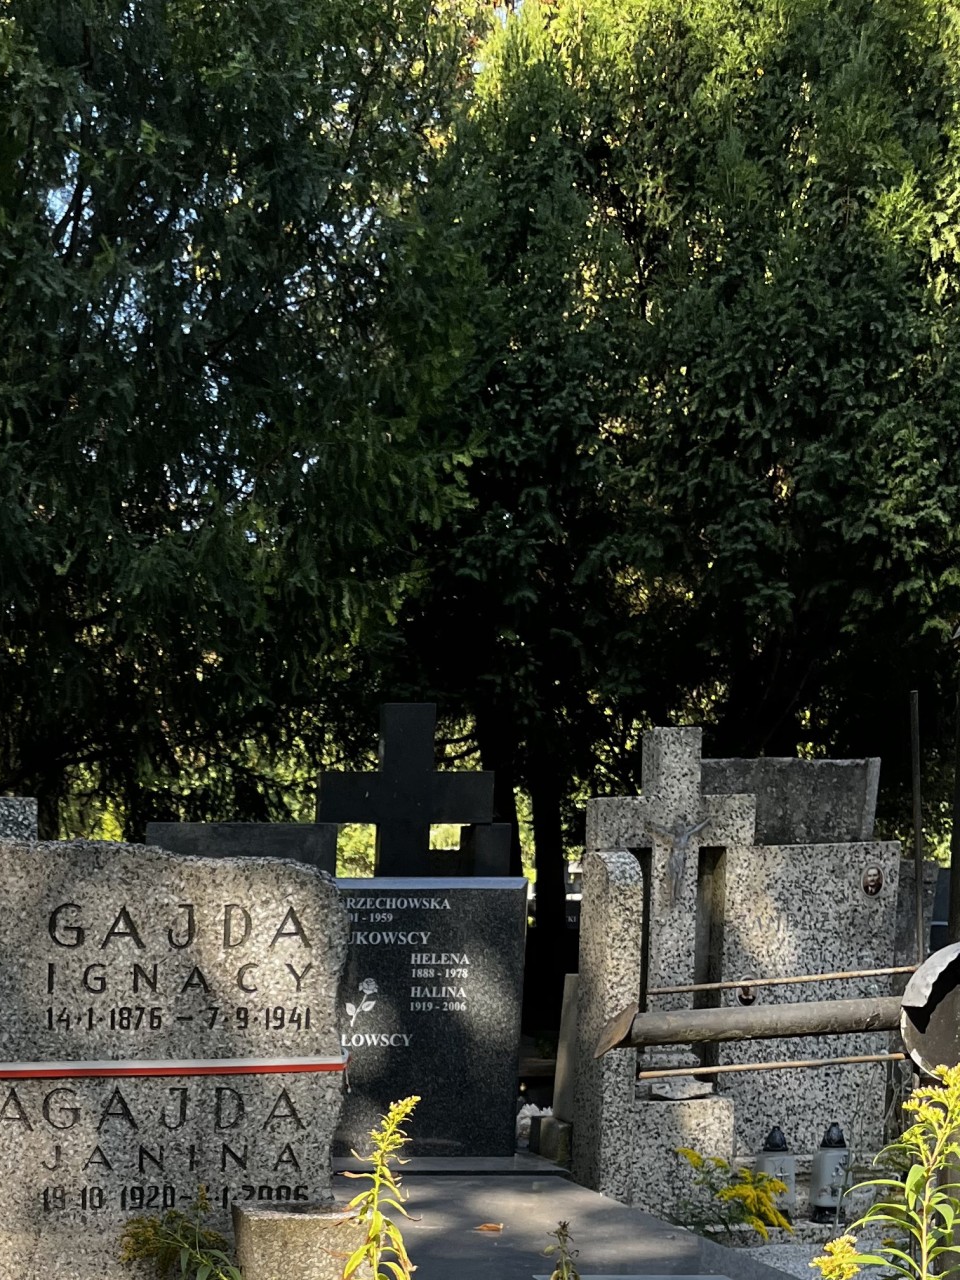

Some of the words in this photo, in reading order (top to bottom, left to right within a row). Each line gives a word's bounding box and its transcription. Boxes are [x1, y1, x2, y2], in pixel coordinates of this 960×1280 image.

[340, 897, 451, 910] RZECHOWSKA
[370, 912, 393, 922] 1959
[48, 903, 312, 949] GAJDA
[411, 953, 470, 965] HELENA
[47, 962, 314, 994] IGNACY
[411, 968, 435, 978] 1888
[445, 968, 469, 978] 1978
[411, 986, 467, 997] HALINA
[411, 1002, 434, 1012] 1919
[443, 1002, 467, 1012] 2006
[43, 1086, 306, 1132] GAJDA
[41, 1144, 301, 1173] JANINA
